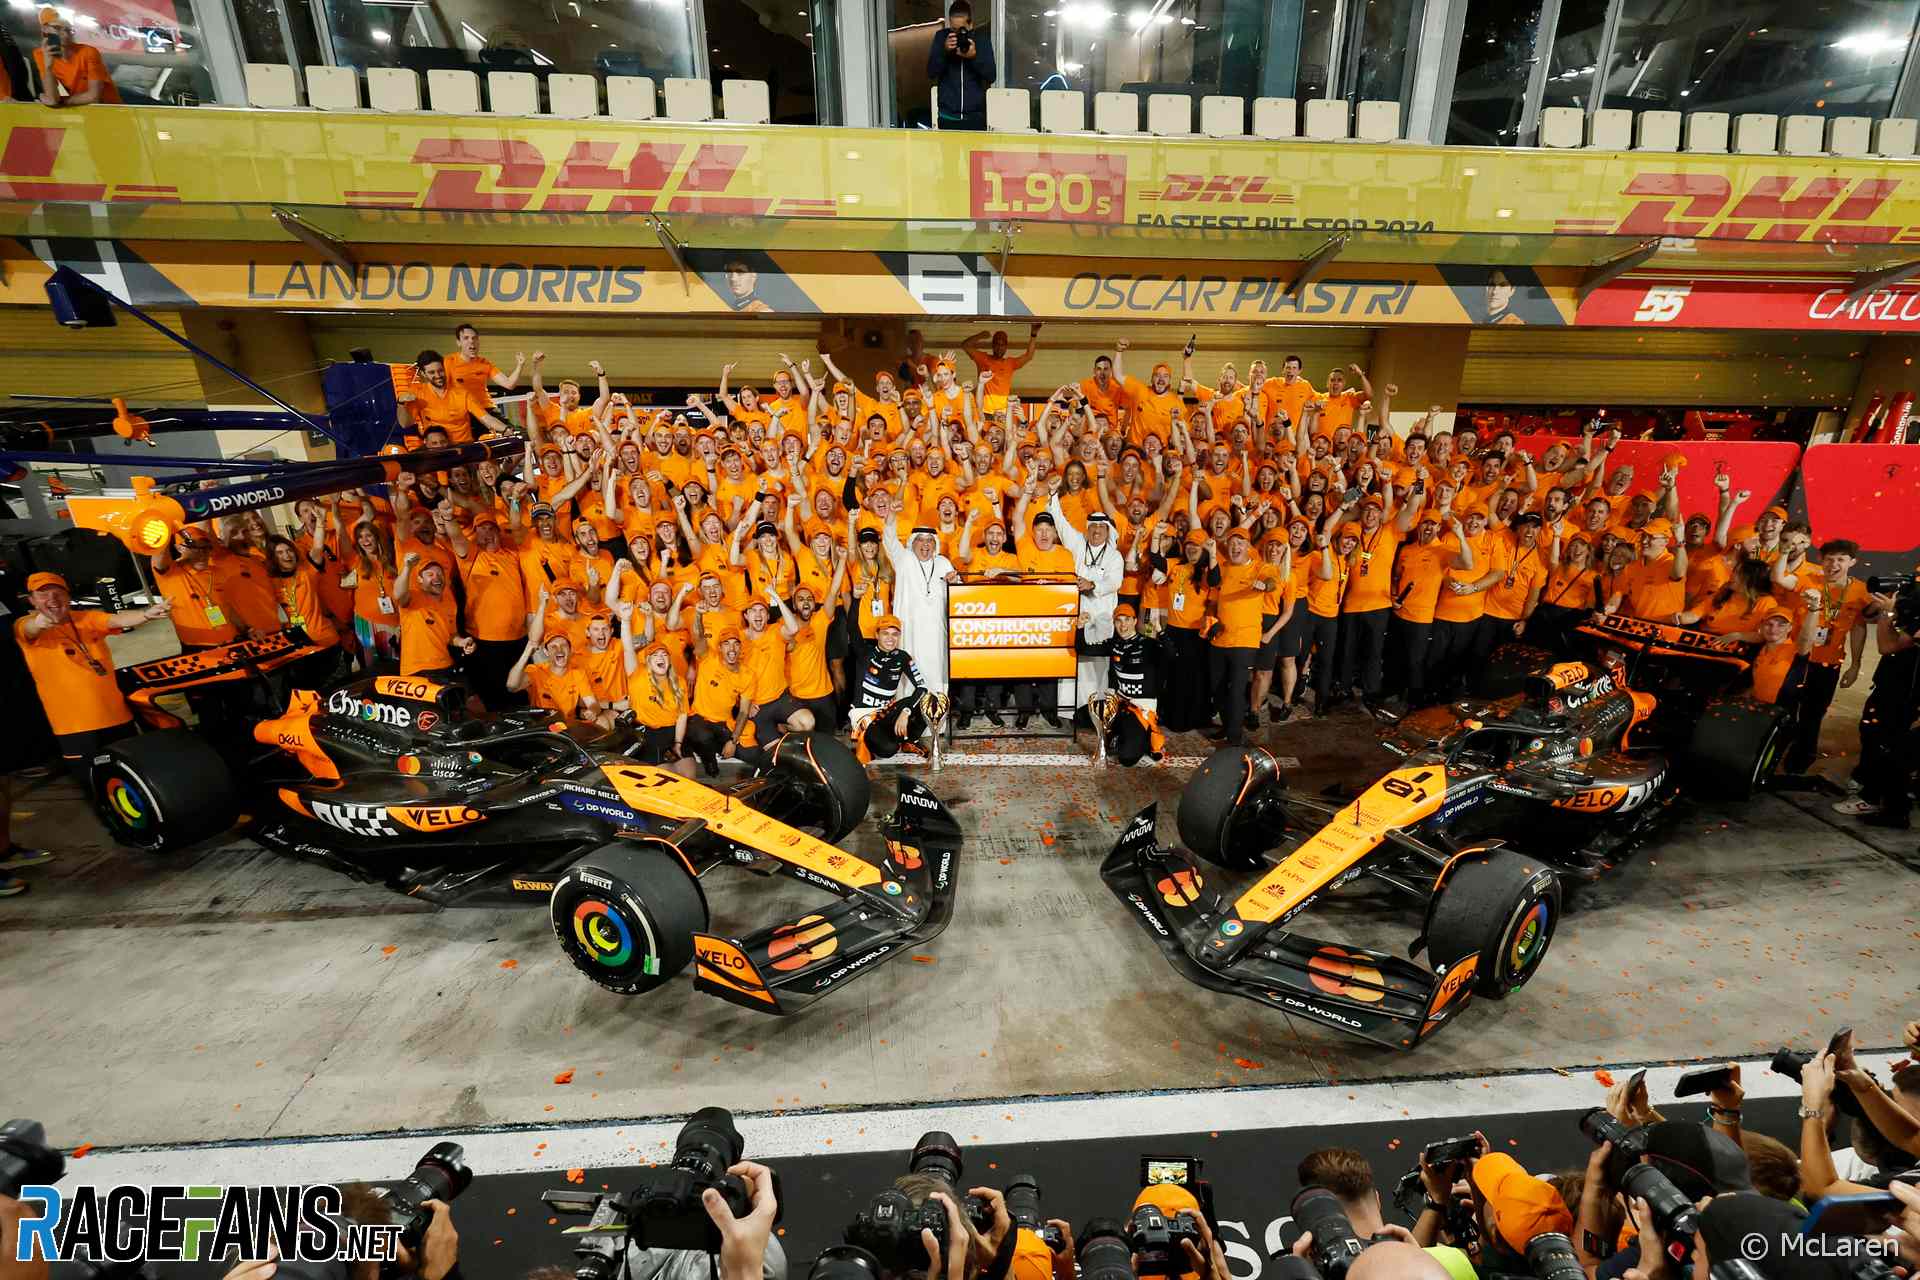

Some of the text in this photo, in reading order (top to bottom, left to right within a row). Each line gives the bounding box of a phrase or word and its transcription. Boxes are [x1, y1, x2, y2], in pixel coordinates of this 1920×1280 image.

[411, 138, 776, 215] DHL
[1160, 174, 1274, 203] DHL
[1615, 173, 1905, 243] DHL
[1137, 213, 1249, 229] FASTEST
[248, 260, 646, 304] LANDO NORRIS
[1063, 272, 1418, 315] OSCAR PIASTRI
[1633, 285, 1693, 321] 55
[209, 487, 284, 511] DP WORLD
[953, 602, 997, 615] 2024
[952, 633, 1052, 646] CHAMPIONS
[1557, 665, 1584, 684] VELO
[386, 679, 428, 699] VELO
[329, 689, 411, 728] Chrome
[432, 769, 456, 778] CISCO
[564, 783, 620, 801] RICHARD MILLE
[406, 808, 484, 831] VELO
[586, 803, 634, 820] DP WORLD
[941, 852, 951, 874] WORLD
[808, 873, 841, 892] SENNA
[698, 947, 745, 971] VELO
[830, 946, 890, 980] DP WORLD
[1442, 969, 1474, 994] VELO
[1285, 998, 1362, 1029] DP WORLD
